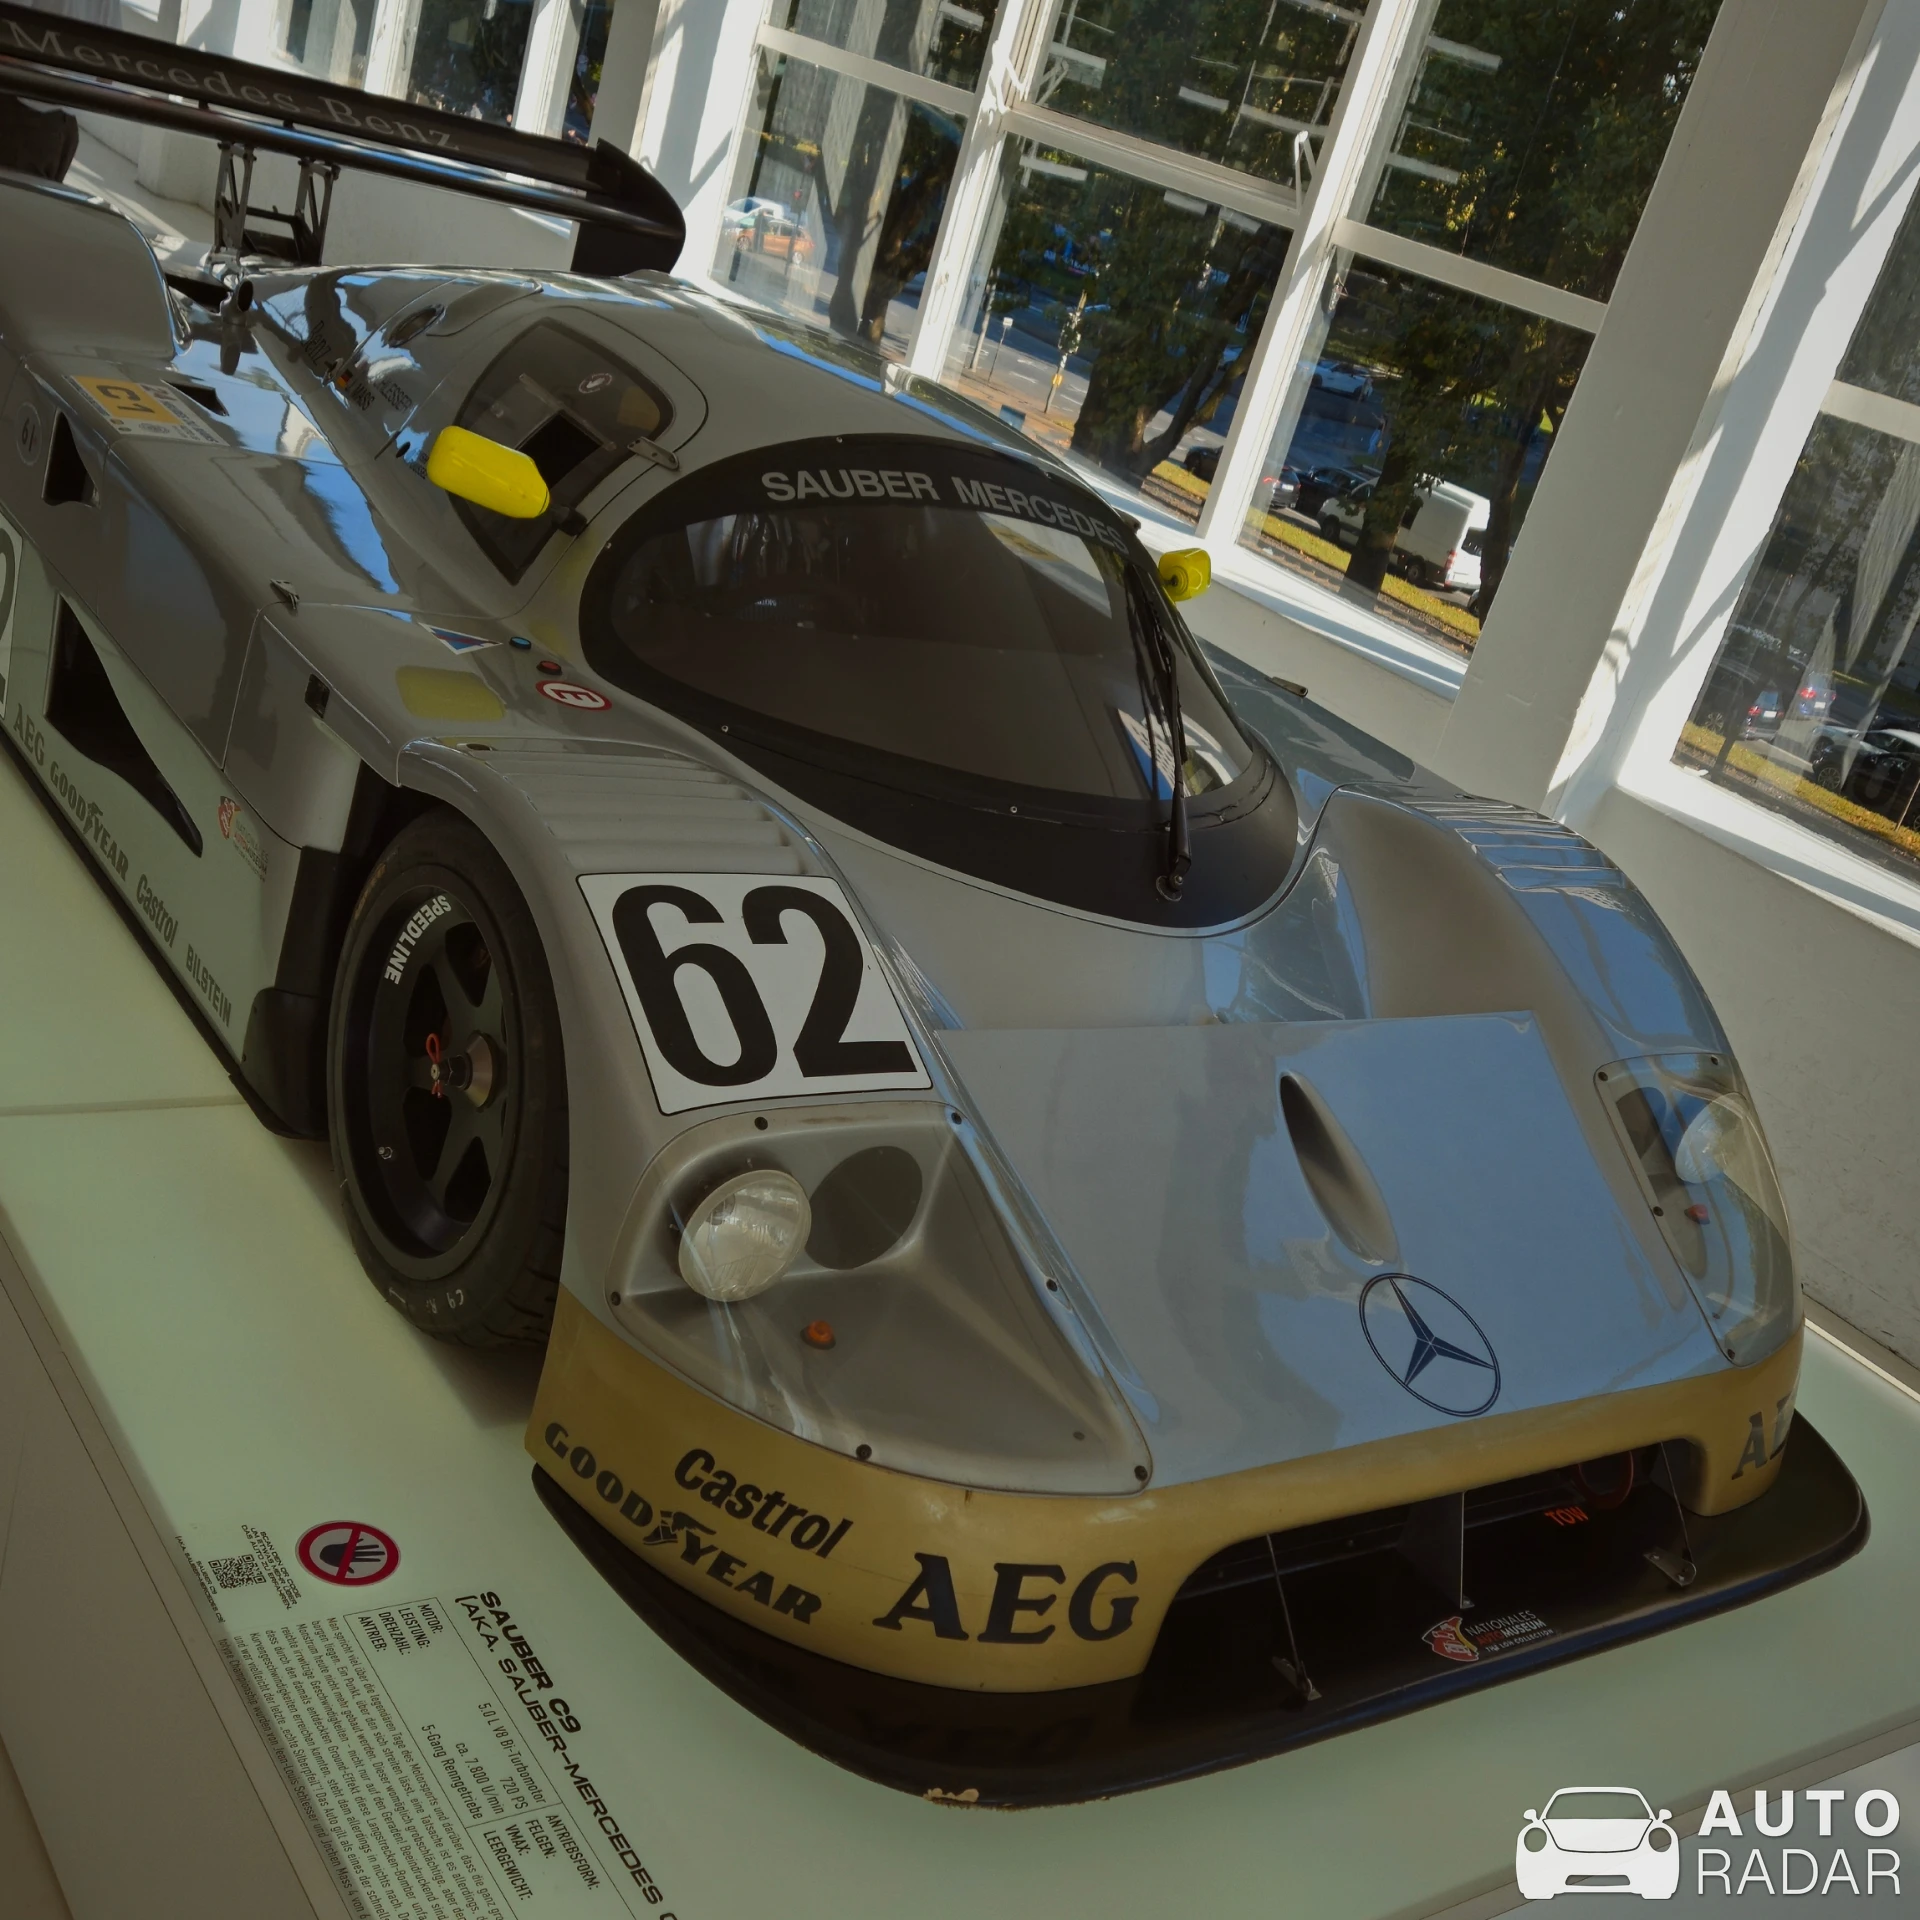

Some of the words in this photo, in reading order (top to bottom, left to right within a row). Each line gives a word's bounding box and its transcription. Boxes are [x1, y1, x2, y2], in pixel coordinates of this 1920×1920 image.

[3, 19, 460, 151] Mercedes-Benz
[761, 469, 941, 502] SAUBER
[951, 476, 1130, 556] MERCEDES
[13, 703, 46, 767] AEG
[136, 873, 180, 948] Castrol
[186, 943, 232, 1028] BILSTEIN
[384, 895, 452, 985] SPEEDLINE
[612, 884, 918, 1087] 62
[673, 1448, 854, 1559] Castrol
[1544, 1505, 1590, 1528] TOW
[378, 1611, 410, 1654] DREHZAHL:
[398, 1607, 430, 1648] LEISTUNG:
[418, 1604, 443, 1633] MOTOR:
[872, 1551, 1141, 1645] AEG
[1464, 1609, 1537, 1637] NATIONALES
[1475, 1618, 1547, 1646] AUTOMUSEUM
[358, 1616, 386, 1651] ANTRIEB:
[481, 1592, 552, 1688] SAUBER
[549, 1698, 581, 1732] C9
[1514, 1628, 1555, 1645] COLLECTION
[421, 1724, 446, 1757] 5-Gang
[441, 1758, 482, 1819] Renngetriebe
[455, 1742, 468, 1757] ca.
[465, 1757, 489, 1784] 7.800
[481, 1785, 504, 1814] U/min
[478, 1702, 496, 1717] 5.0
[492, 1725, 508, 1738] V8
[500, 1739, 545, 1802] Bi-Turbomotor
[499, 1776, 519, 1794] 720
[511, 1795, 528, 1809] PS
[483, 1830, 532, 1899] LEERGEWICHT:
[505, 1824, 530, 1855] VMAX:
[525, 1819, 556, 1858] FELGEN:
[546, 1815, 598, 1889] ANTRIEBSFORM:
